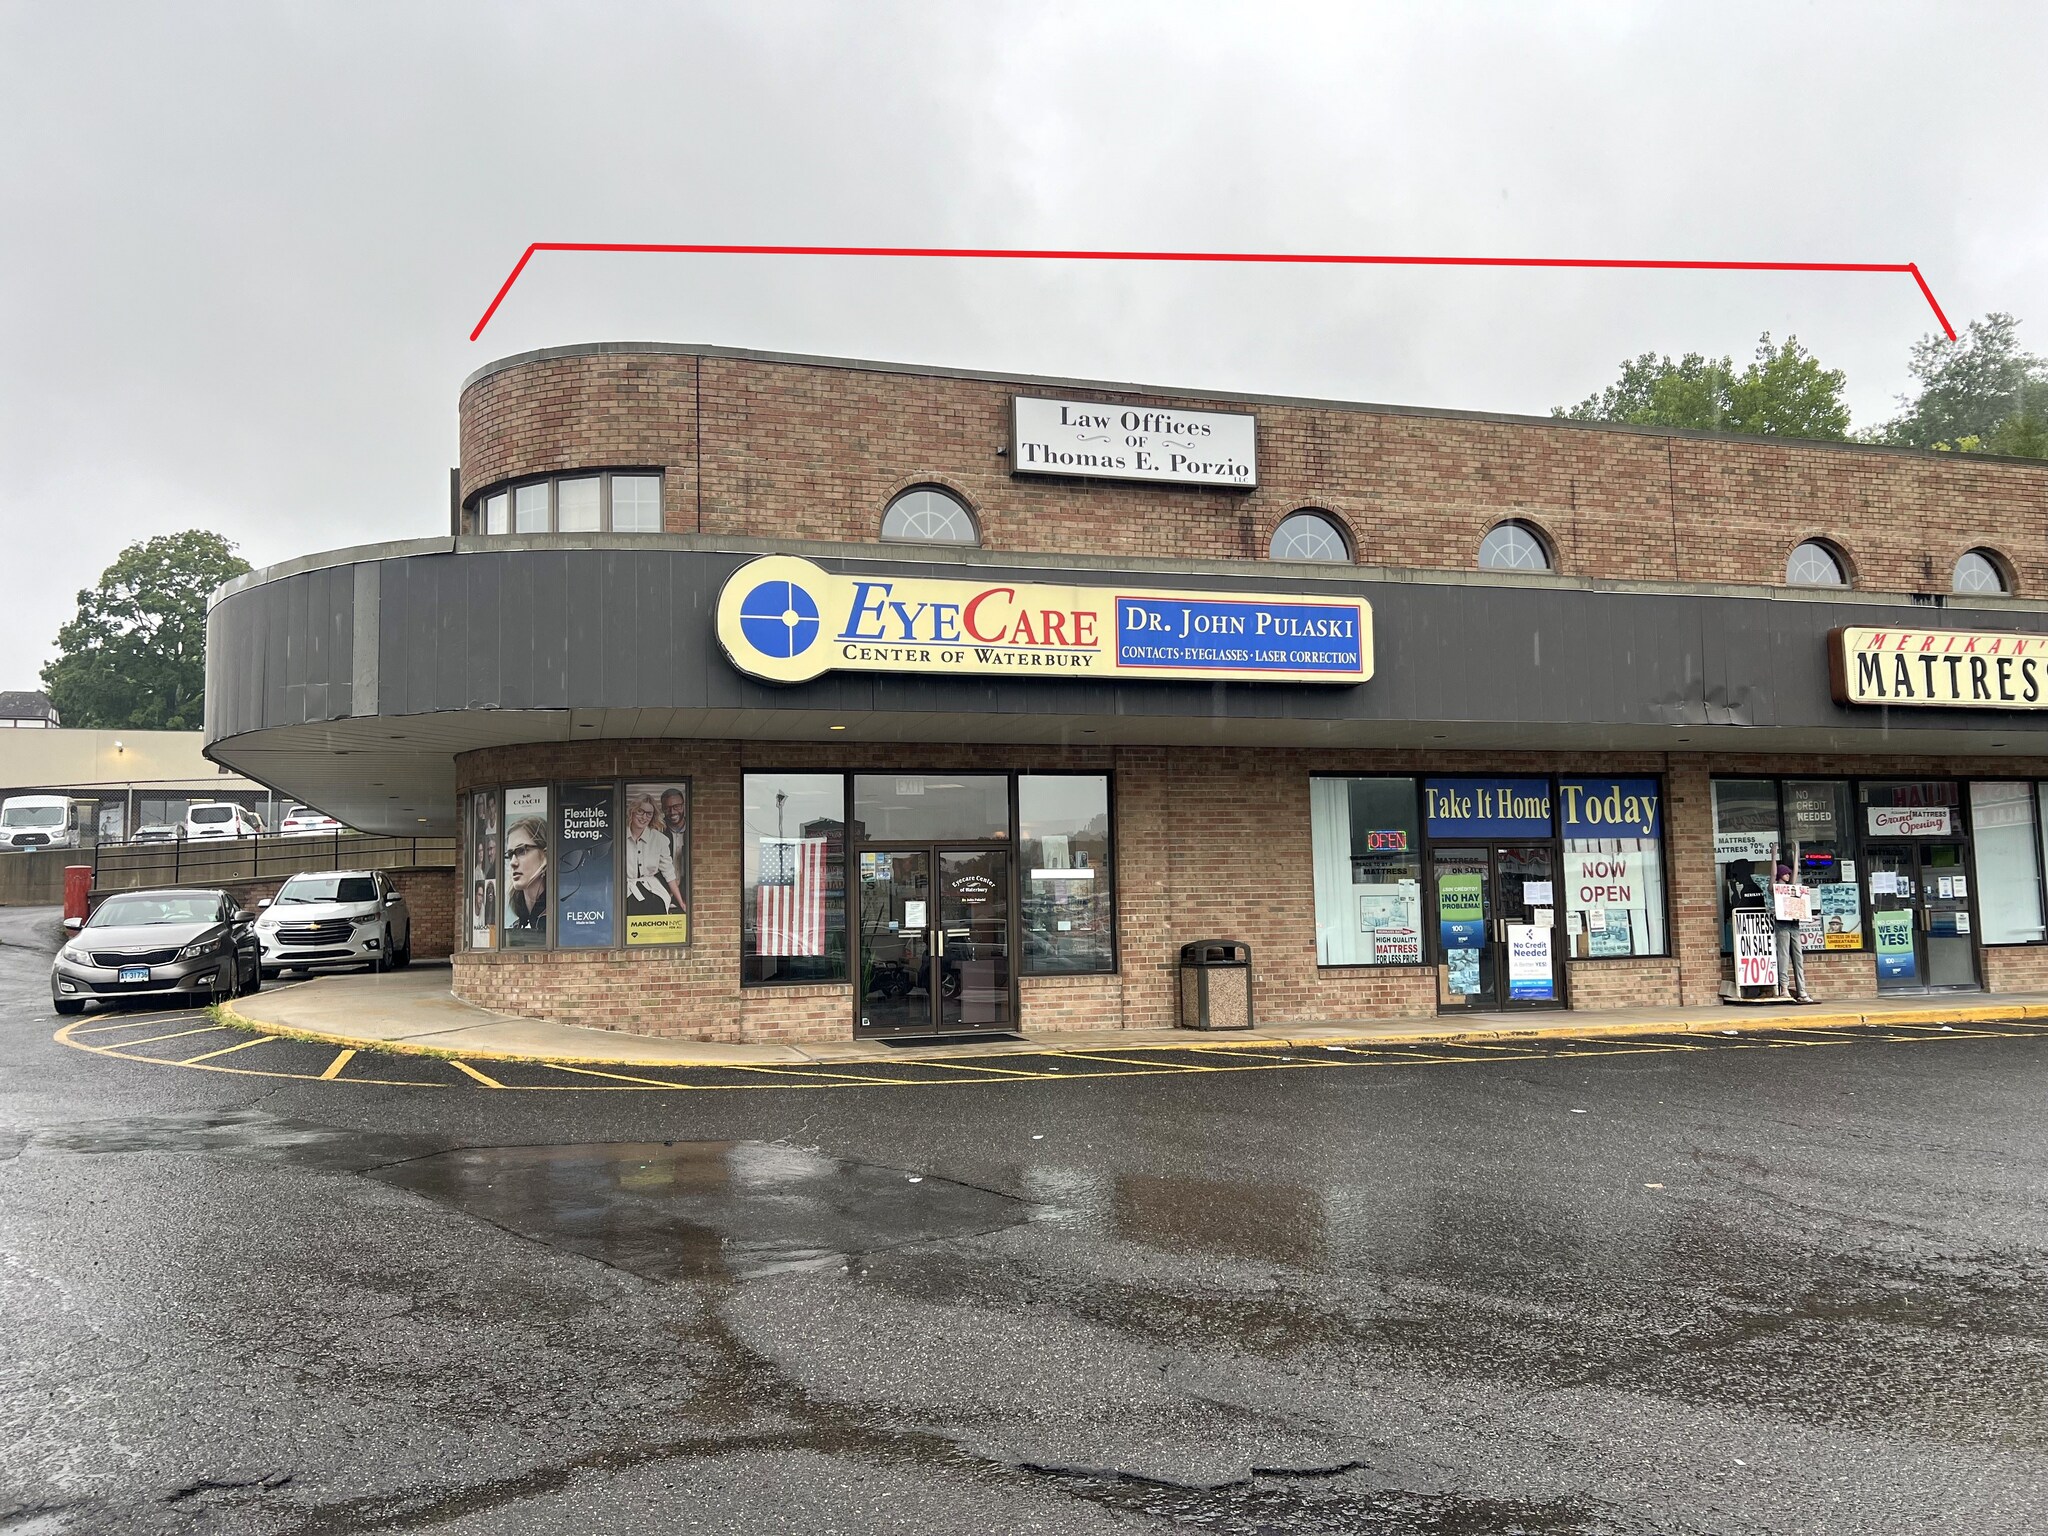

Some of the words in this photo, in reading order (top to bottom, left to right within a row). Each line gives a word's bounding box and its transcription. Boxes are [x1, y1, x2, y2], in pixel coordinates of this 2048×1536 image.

[1060, 406, 1110, 429] Law
[1120, 411, 1211, 436] Offices
[1125, 435, 1147, 448] OF
[1022, 443, 1125, 469] Thomas
[1135, 451, 1159, 471] E.
[1169, 453, 1249, 477] Porzio
[1289, 651, 1357, 664] CORRECTION
[1857, 652, 2048, 702] MATTRES
[1796, 790, 1809, 800] NO
[1425, 788, 1471, 819] Take
[1476, 788, 1493, 819] It
[1497, 788, 1550, 820] Home
[1559, 785, 1658, 834] Today
[1796, 801, 1827, 811] CREDIT
[564, 808, 608, 819] Flexible.
[1797, 812, 1832, 822] NEEDED
[1876, 811, 1913, 826] Grand
[564, 818, 609, 829] Durable.
[1900, 819, 1943, 834] Opening
[564, 829, 603, 840] Strong.
[1370, 833, 1405, 848] OPEN
[1718, 836, 1756, 844] MATTRESS
[1583, 862, 1626, 878] NOW
[1461, 893, 1480, 902] HAY
[1580, 886, 1631, 902] OPEN
[567, 911, 605, 921] FLEXON
[1735, 914, 1775, 935] MATTRESS
[1893, 925, 1908, 933] SAY
[1740, 935, 1752, 956] ON
[1753, 935, 1772, 956] SALE
[1879, 933, 1909, 946] YES!
[1376, 945, 1418, 954] MATTRESS
[1514, 949, 1547, 957] Needed
[1741, 957, 1774, 984] 70%
